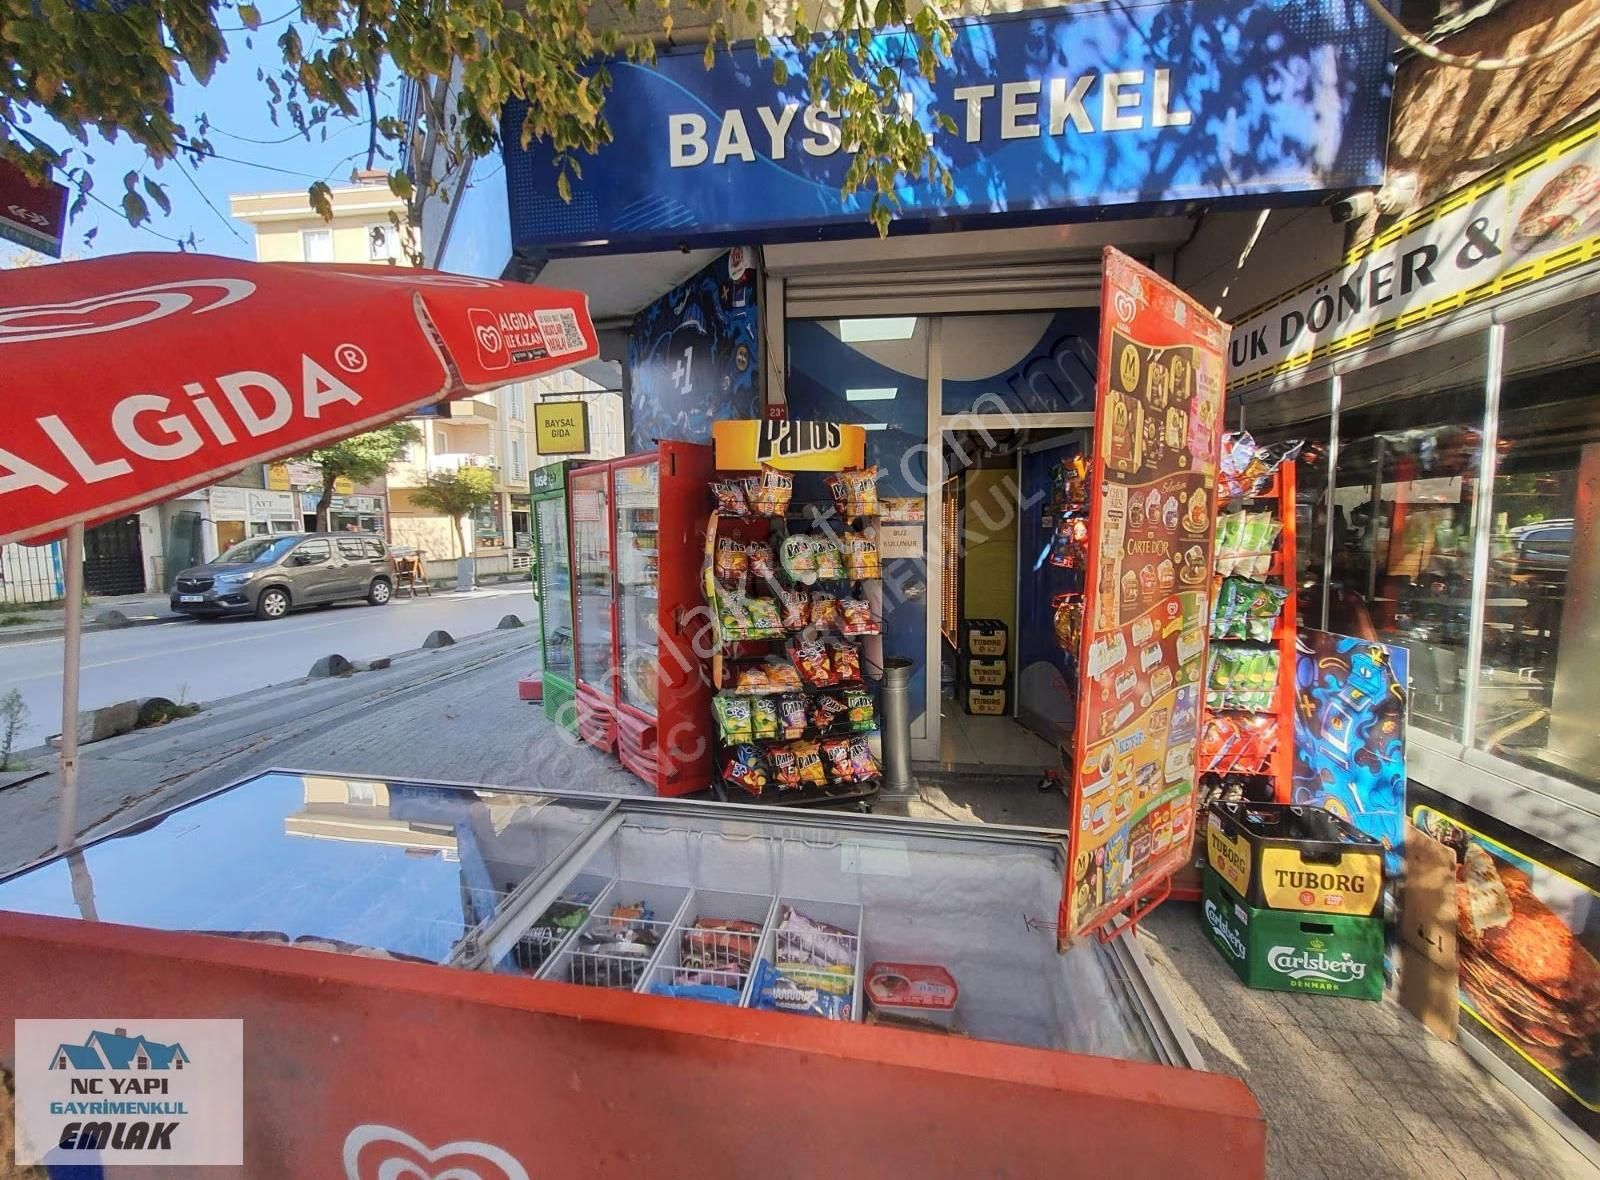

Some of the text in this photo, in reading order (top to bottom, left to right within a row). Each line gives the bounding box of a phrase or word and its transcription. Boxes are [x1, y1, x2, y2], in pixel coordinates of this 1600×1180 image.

[668, 67, 1193, 169] BAYSL TEKEL
[1228, 216, 1503, 369] UK DÖNER &
[544, 418, 576, 429] BAYSAL
[551, 429, 571, 438] GIDA
[1127, 538, 1152, 556] CARTE
[1211, 833, 1246, 875] TUBORG
[1275, 869, 1365, 894] TUBORG
[1204, 899, 1246, 960] Carlsberg
[1267, 945, 1366, 980] Carlsberg
[1290, 980, 1340, 992] DENMARK
